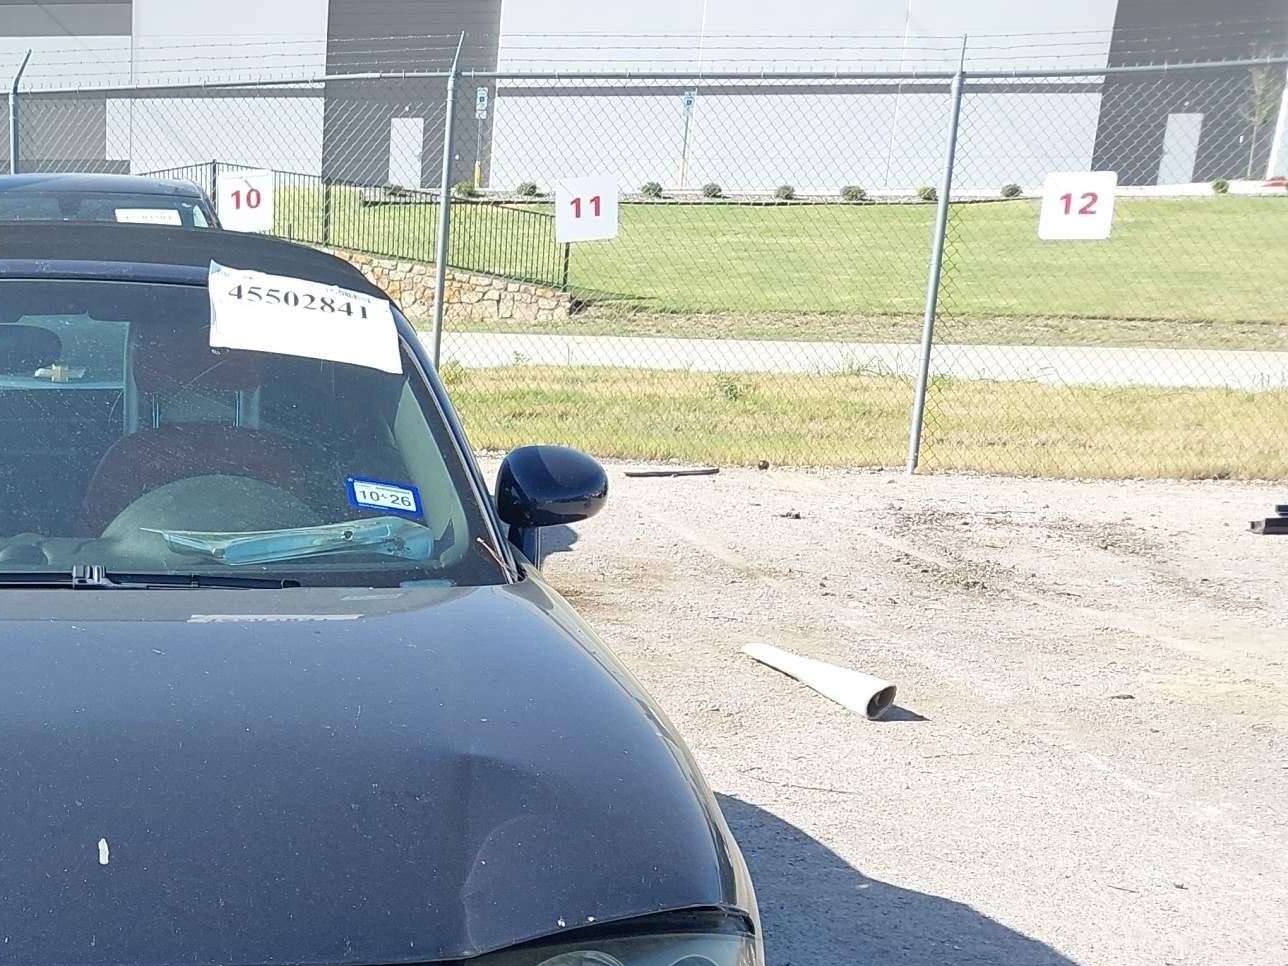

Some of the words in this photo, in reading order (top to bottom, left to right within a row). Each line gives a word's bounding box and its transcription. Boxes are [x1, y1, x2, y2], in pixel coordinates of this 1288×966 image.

[231, 188, 261, 210] 10
[570, 195, 601, 218] 11
[1059, 191, 1099, 215] 12
[228, 284, 369, 319] 45502841
[360, 490, 380, 502] 10
[390, 494, 412, 507] 26
